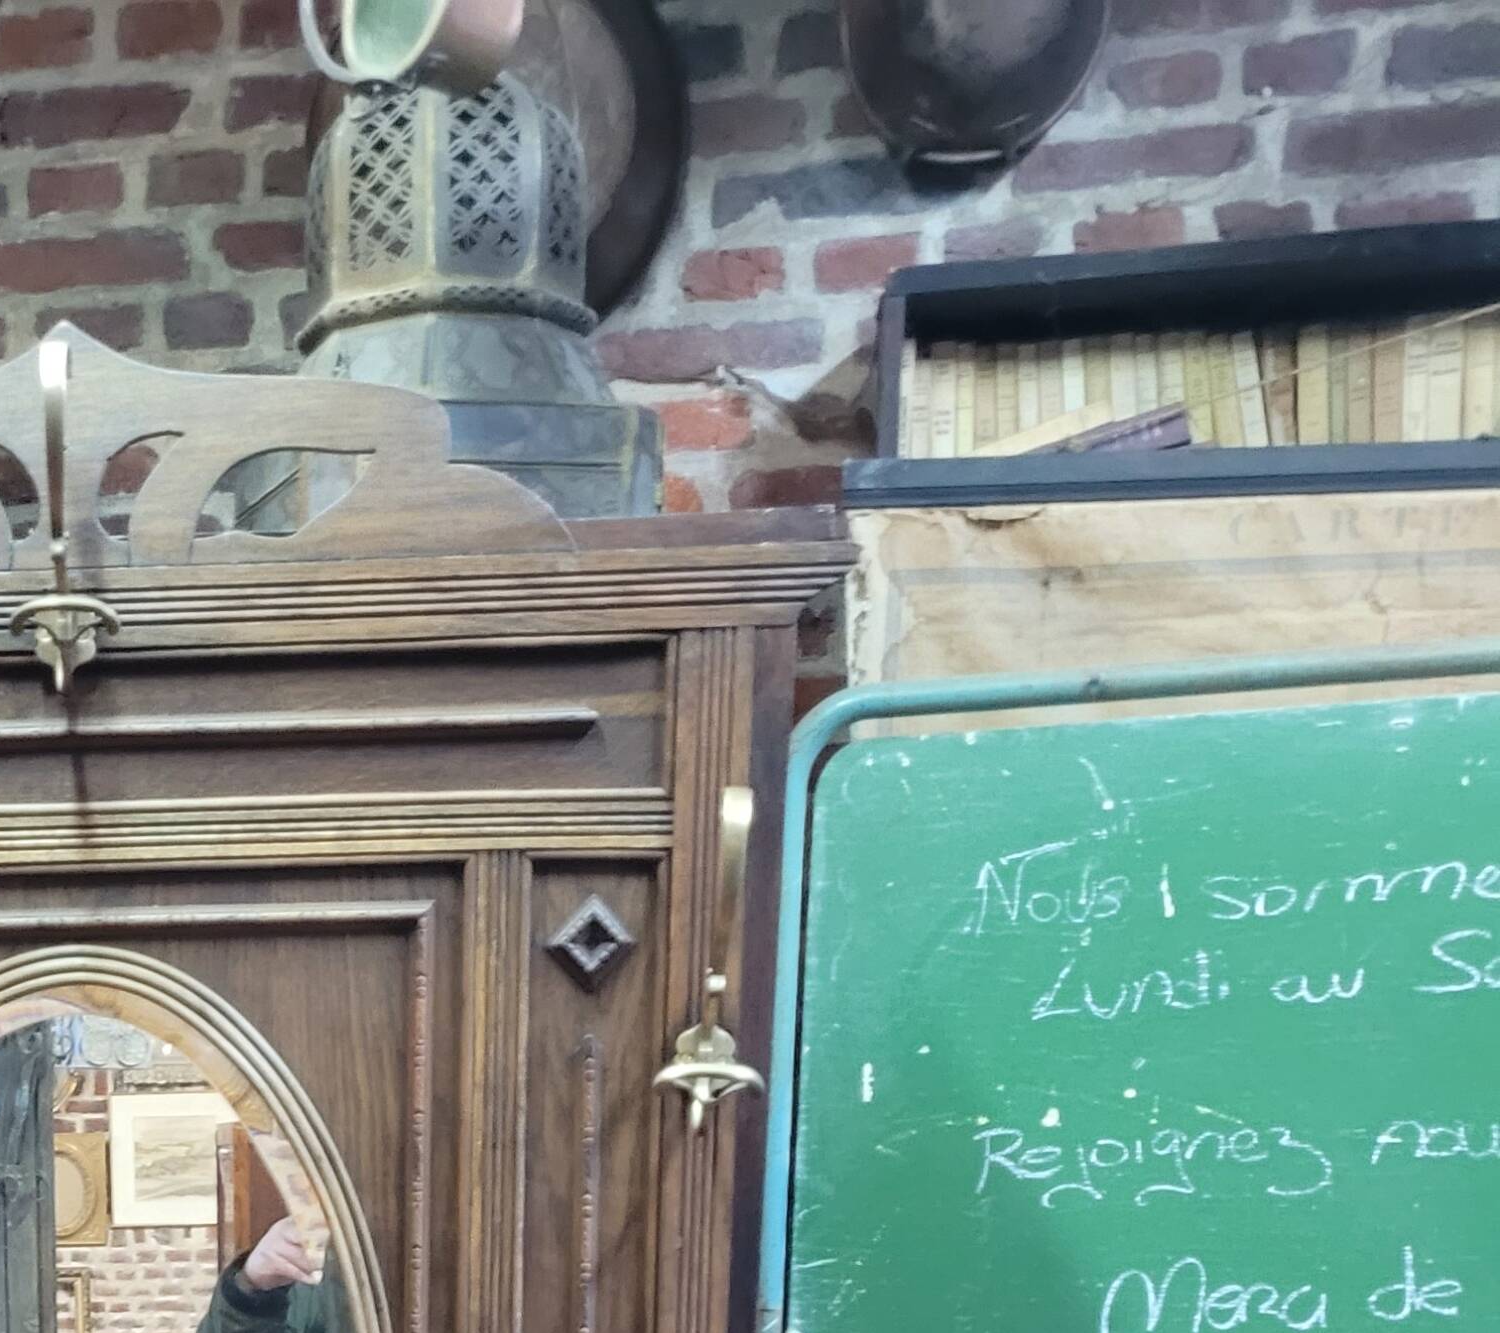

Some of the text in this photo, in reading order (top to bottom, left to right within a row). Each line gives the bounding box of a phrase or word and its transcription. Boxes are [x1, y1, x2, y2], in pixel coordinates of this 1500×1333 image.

[975, 839, 1129, 936] Nous
[1032, 950, 1230, 1020] Lundi
[1270, 969, 1364, 1003] au
[973, 1127, 1333, 1207] Rejoignez
[1368, 1246, 1462, 1320] de
